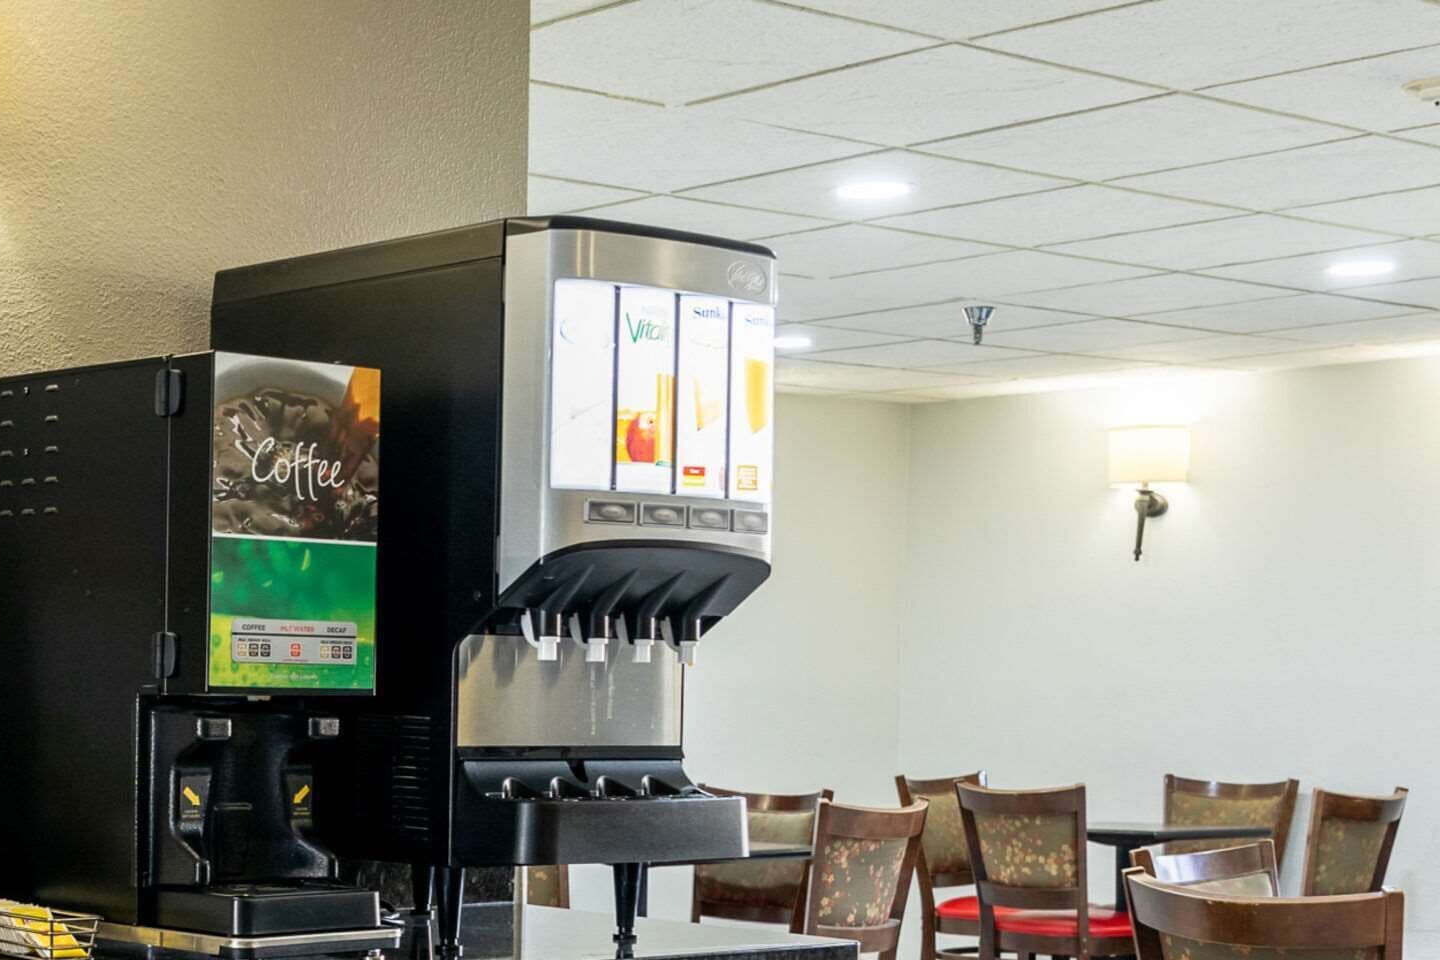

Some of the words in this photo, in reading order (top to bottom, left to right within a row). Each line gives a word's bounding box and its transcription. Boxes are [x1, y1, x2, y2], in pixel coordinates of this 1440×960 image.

[251, 437, 345, 501] Coffee
[241, 623, 266, 632] COFFEE
[326, 626, 347, 634] DECAF
